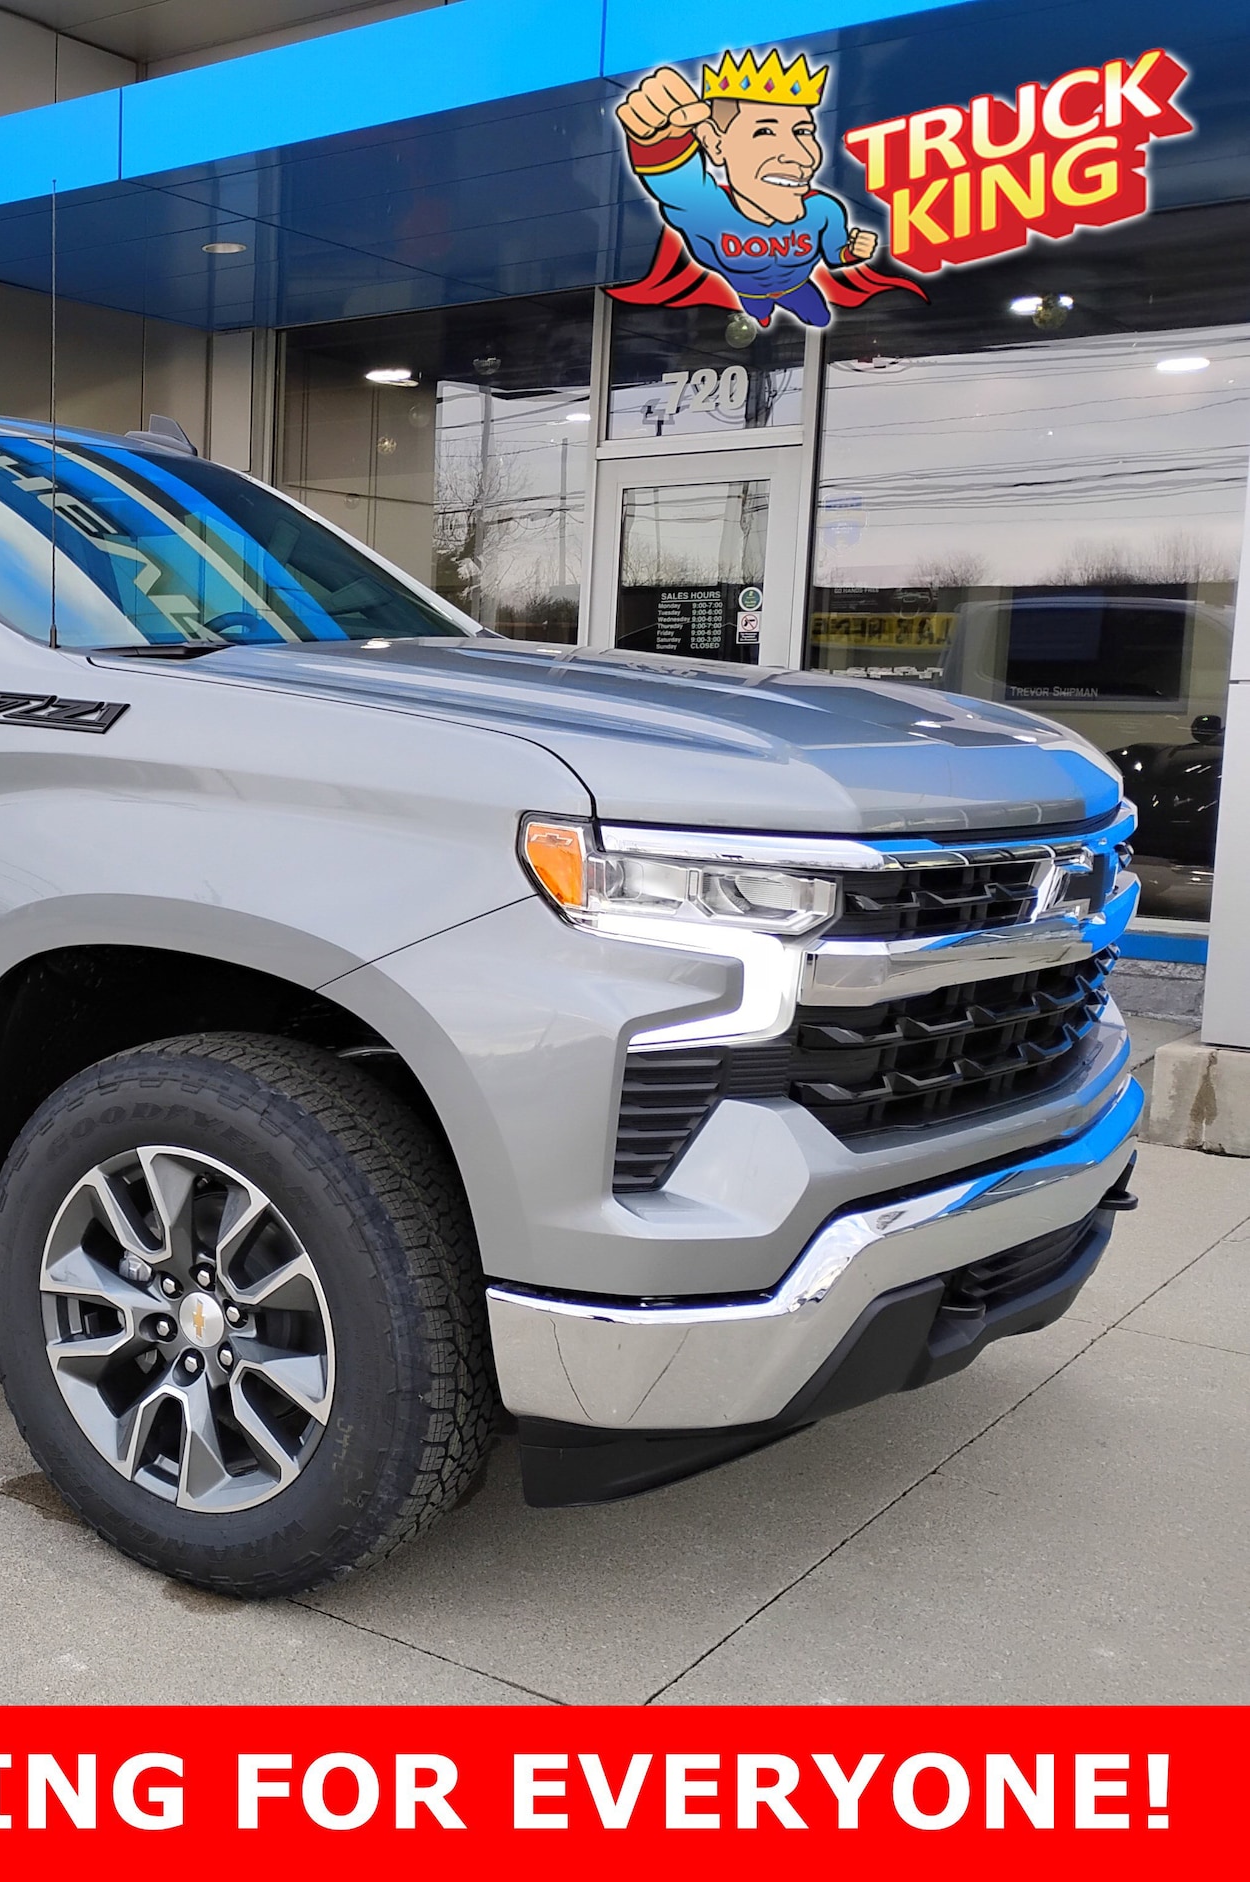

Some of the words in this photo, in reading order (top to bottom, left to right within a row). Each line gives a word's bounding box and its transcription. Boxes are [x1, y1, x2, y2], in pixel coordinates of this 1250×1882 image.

[662, 365, 749, 415] 720
[661, 592, 689, 601] SALES
[690, 591, 721, 600] HOURS
[1010, 686, 1049, 697] TREVOR
[1052, 686, 1098, 697] SHIPMAN
